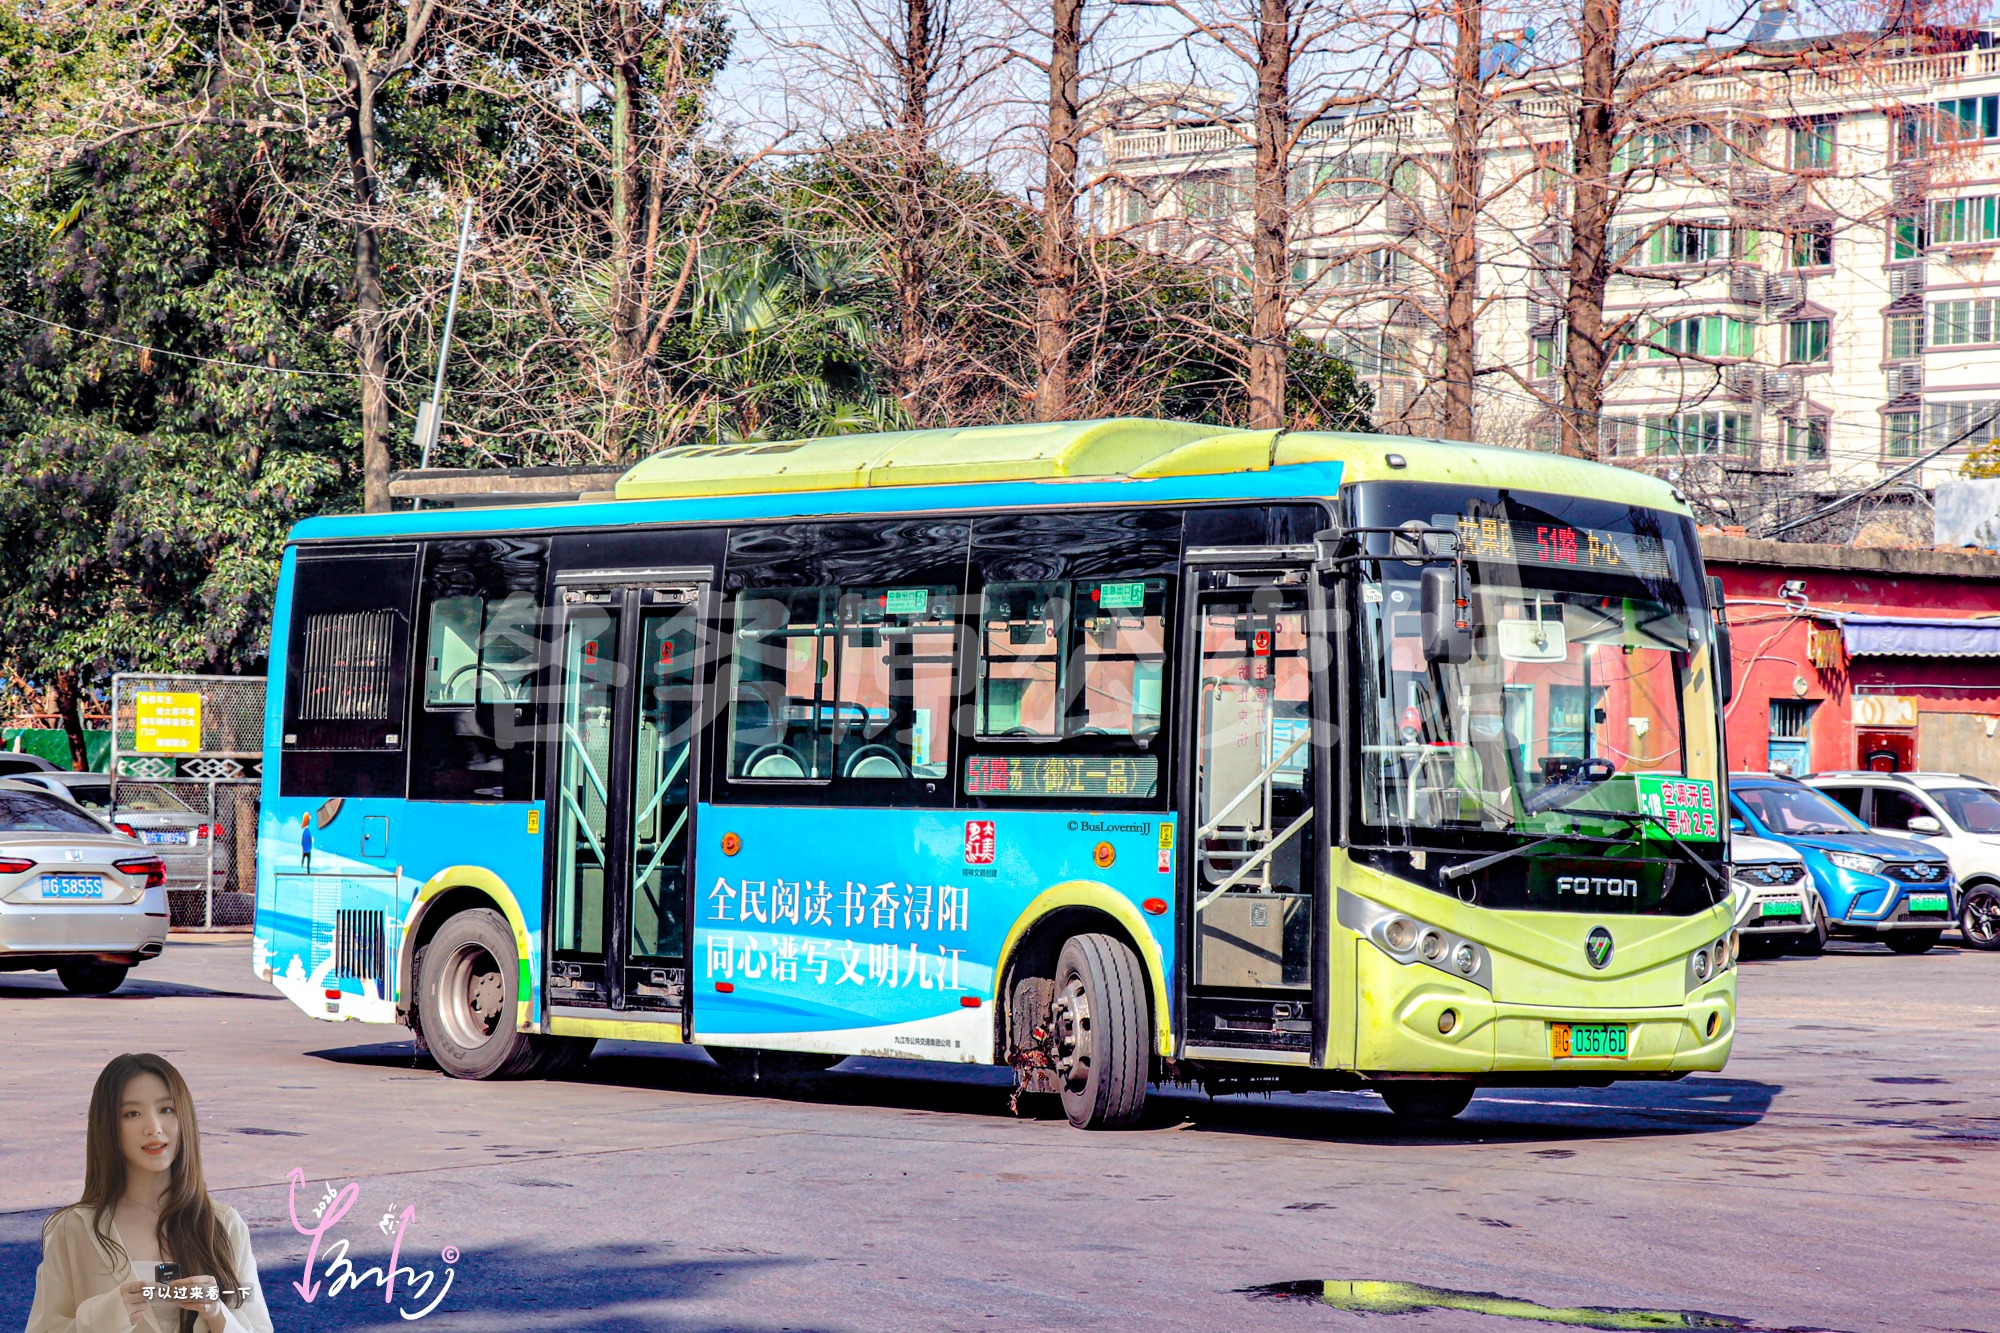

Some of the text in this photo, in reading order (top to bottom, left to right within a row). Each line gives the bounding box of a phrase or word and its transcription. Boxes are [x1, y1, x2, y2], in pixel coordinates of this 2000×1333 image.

[1537, 526, 1578, 564] 51路
[1102, 585, 1131, 595] 应急出口
[968, 756, 1009, 792] 51路
[1660, 781, 1714, 810] 空调开启
[1665, 809, 1717, 838] 票价2元
[1557, 876, 1638, 897] FOTON
[707, 876, 969, 932] 全民阅读书香浔阳
[706, 934, 969, 992] 同心谱写文明九江
